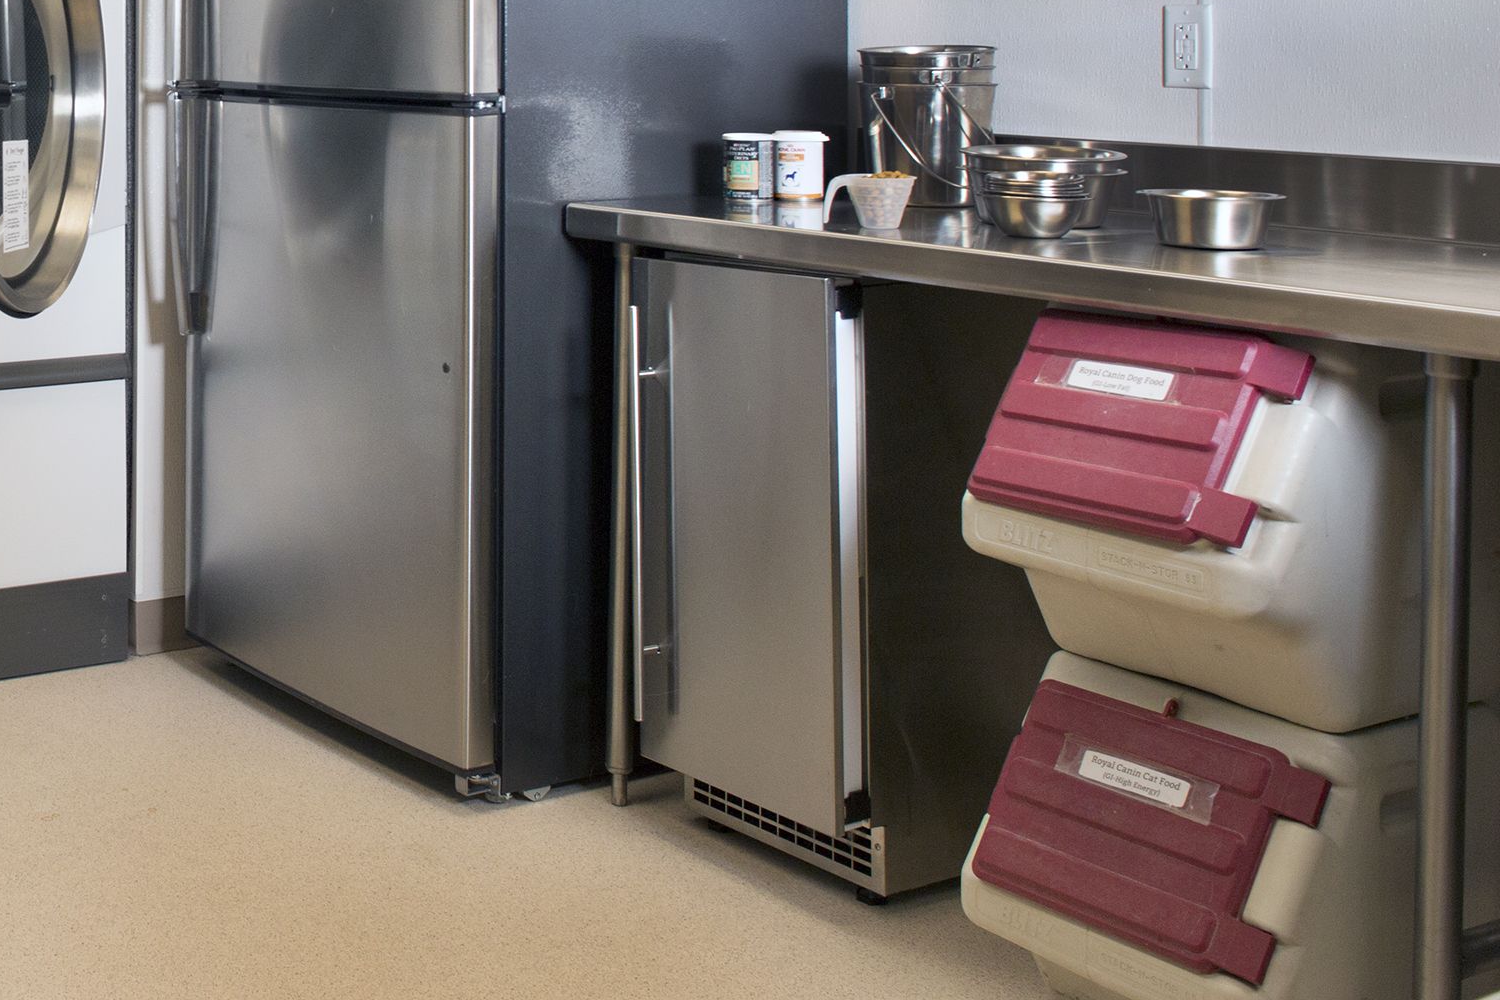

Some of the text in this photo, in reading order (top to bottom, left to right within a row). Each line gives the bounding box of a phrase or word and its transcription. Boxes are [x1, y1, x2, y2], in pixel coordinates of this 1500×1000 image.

[1079, 366, 1165, 387] Royal Canin Dog Food
[1000, 519, 1055, 551] BLITZ
[1092, 755, 1181, 791] Royal Canin Cat Food
[1133, 782, 1161, 797] Energy)
